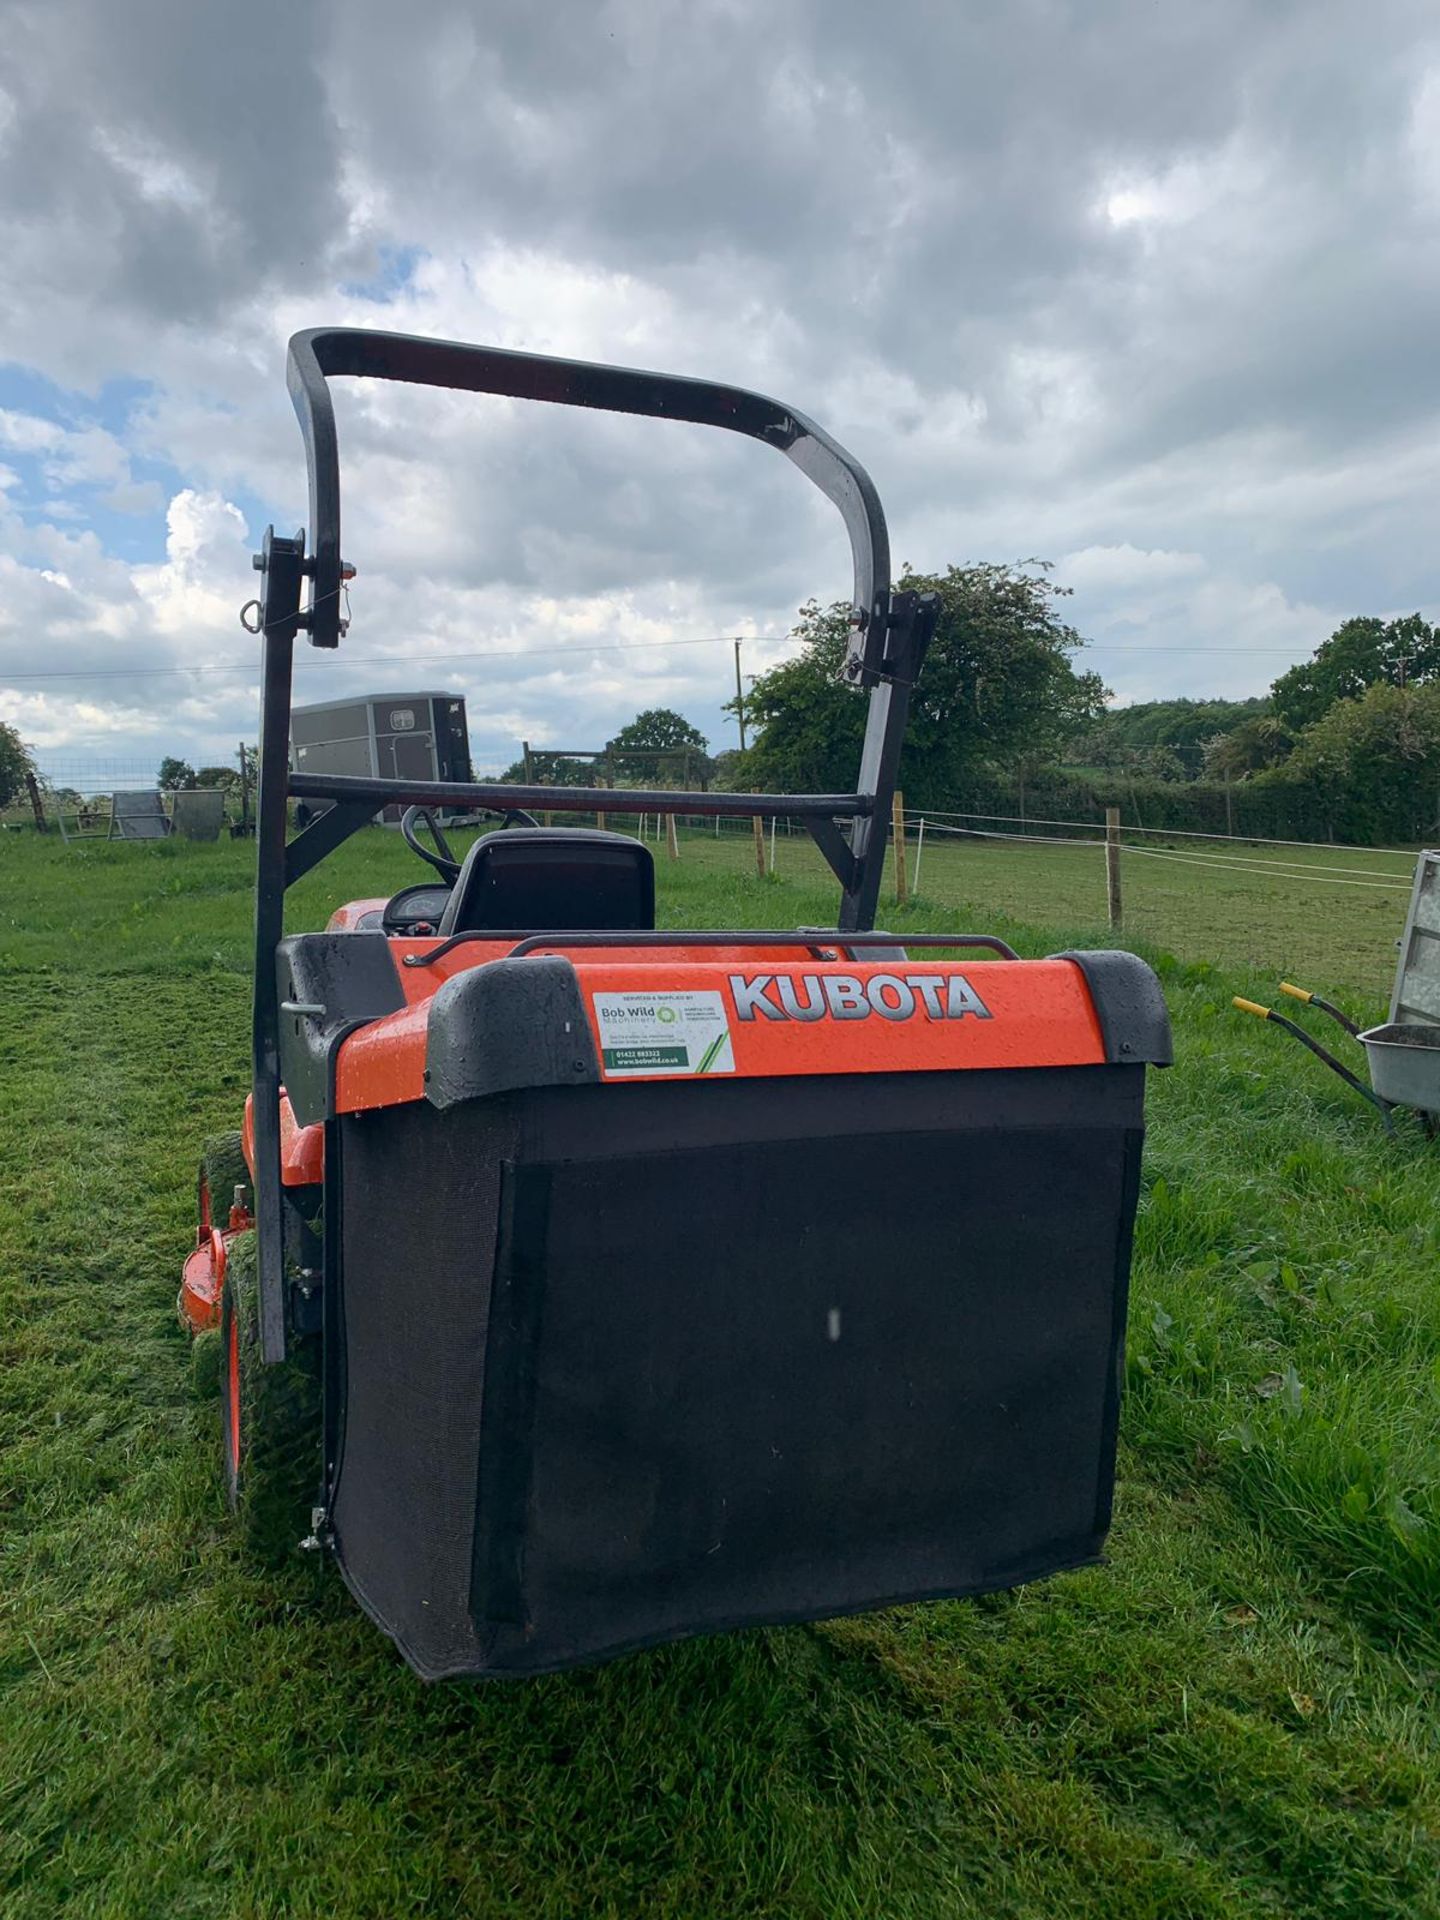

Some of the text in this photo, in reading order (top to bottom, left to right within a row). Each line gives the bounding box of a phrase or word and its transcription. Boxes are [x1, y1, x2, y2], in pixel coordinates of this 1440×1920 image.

[728, 974, 994, 1022] KUBOTA
[602, 1006, 655, 1018] Bob Wild
[603, 1016, 656, 1024] Machinery
[617, 1057, 679, 1065] www.bobwild.co.uk
